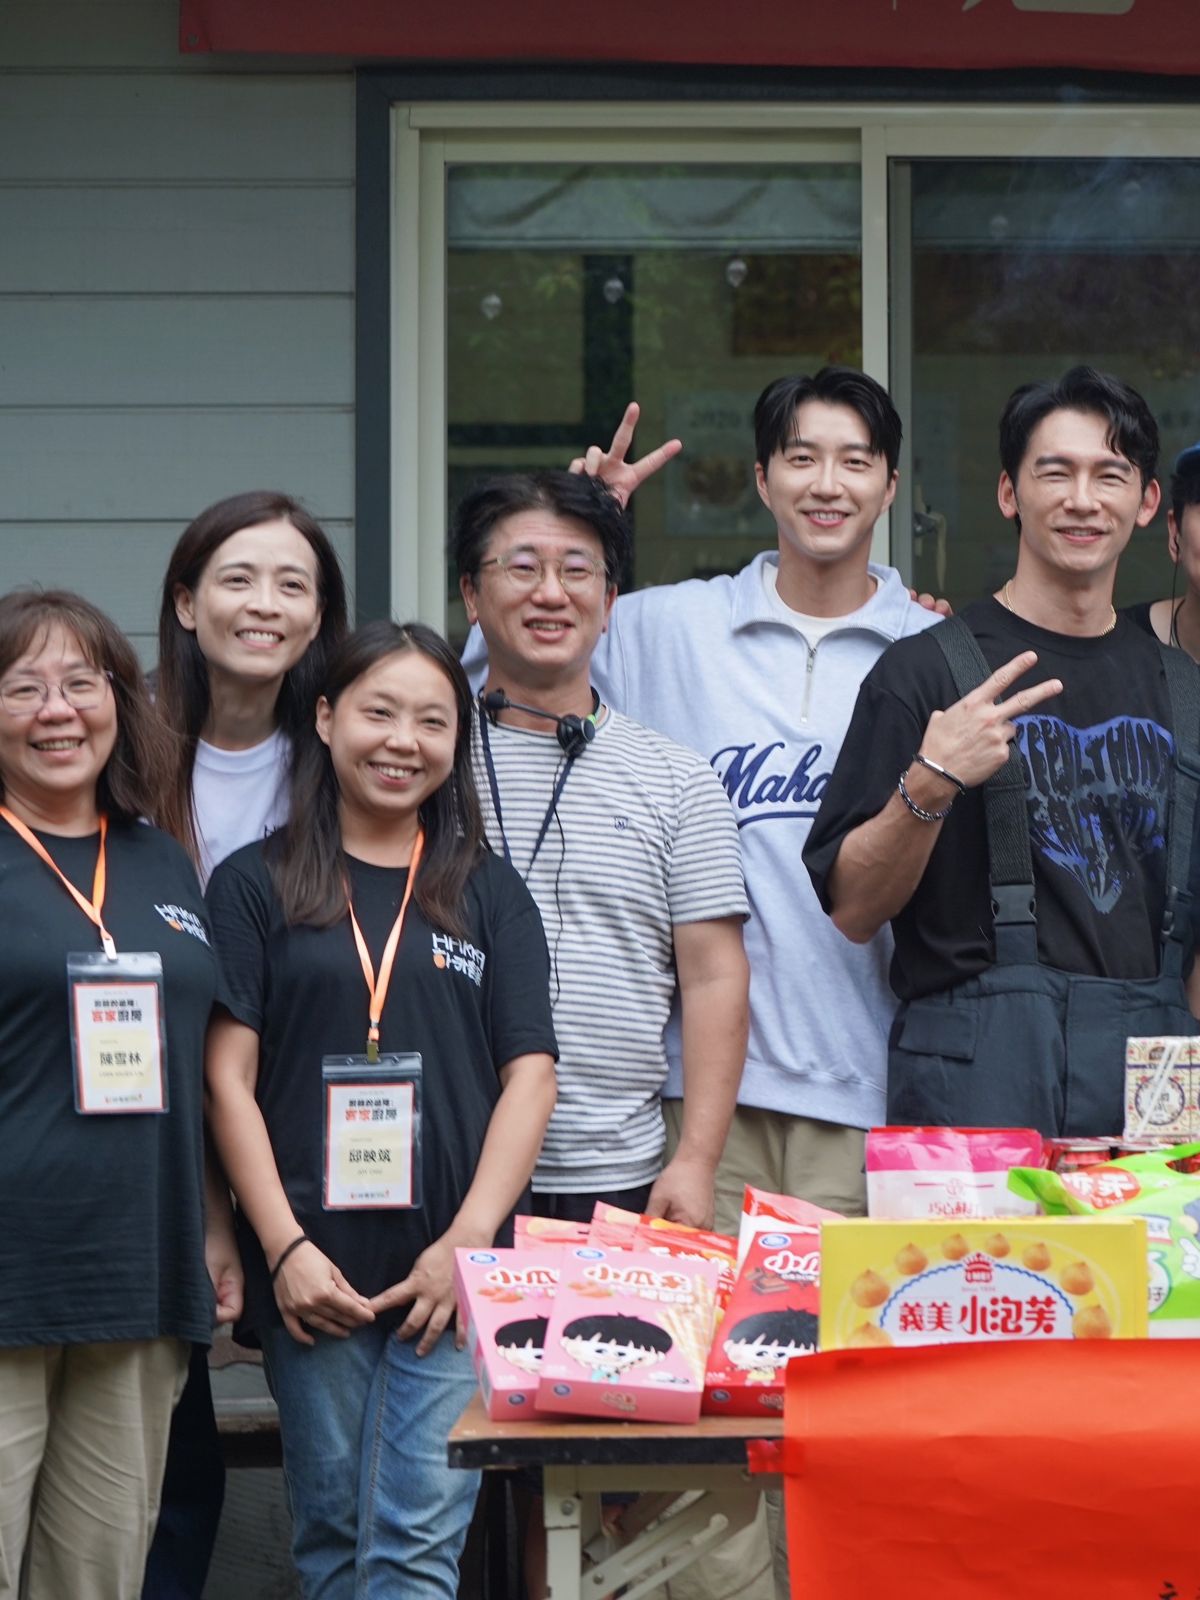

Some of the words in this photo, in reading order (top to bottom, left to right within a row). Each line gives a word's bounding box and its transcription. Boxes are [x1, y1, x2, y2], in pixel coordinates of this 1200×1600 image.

[899, 1301, 953, 1332] 義美
[959, 1295, 1057, 1336] 小泡芙
